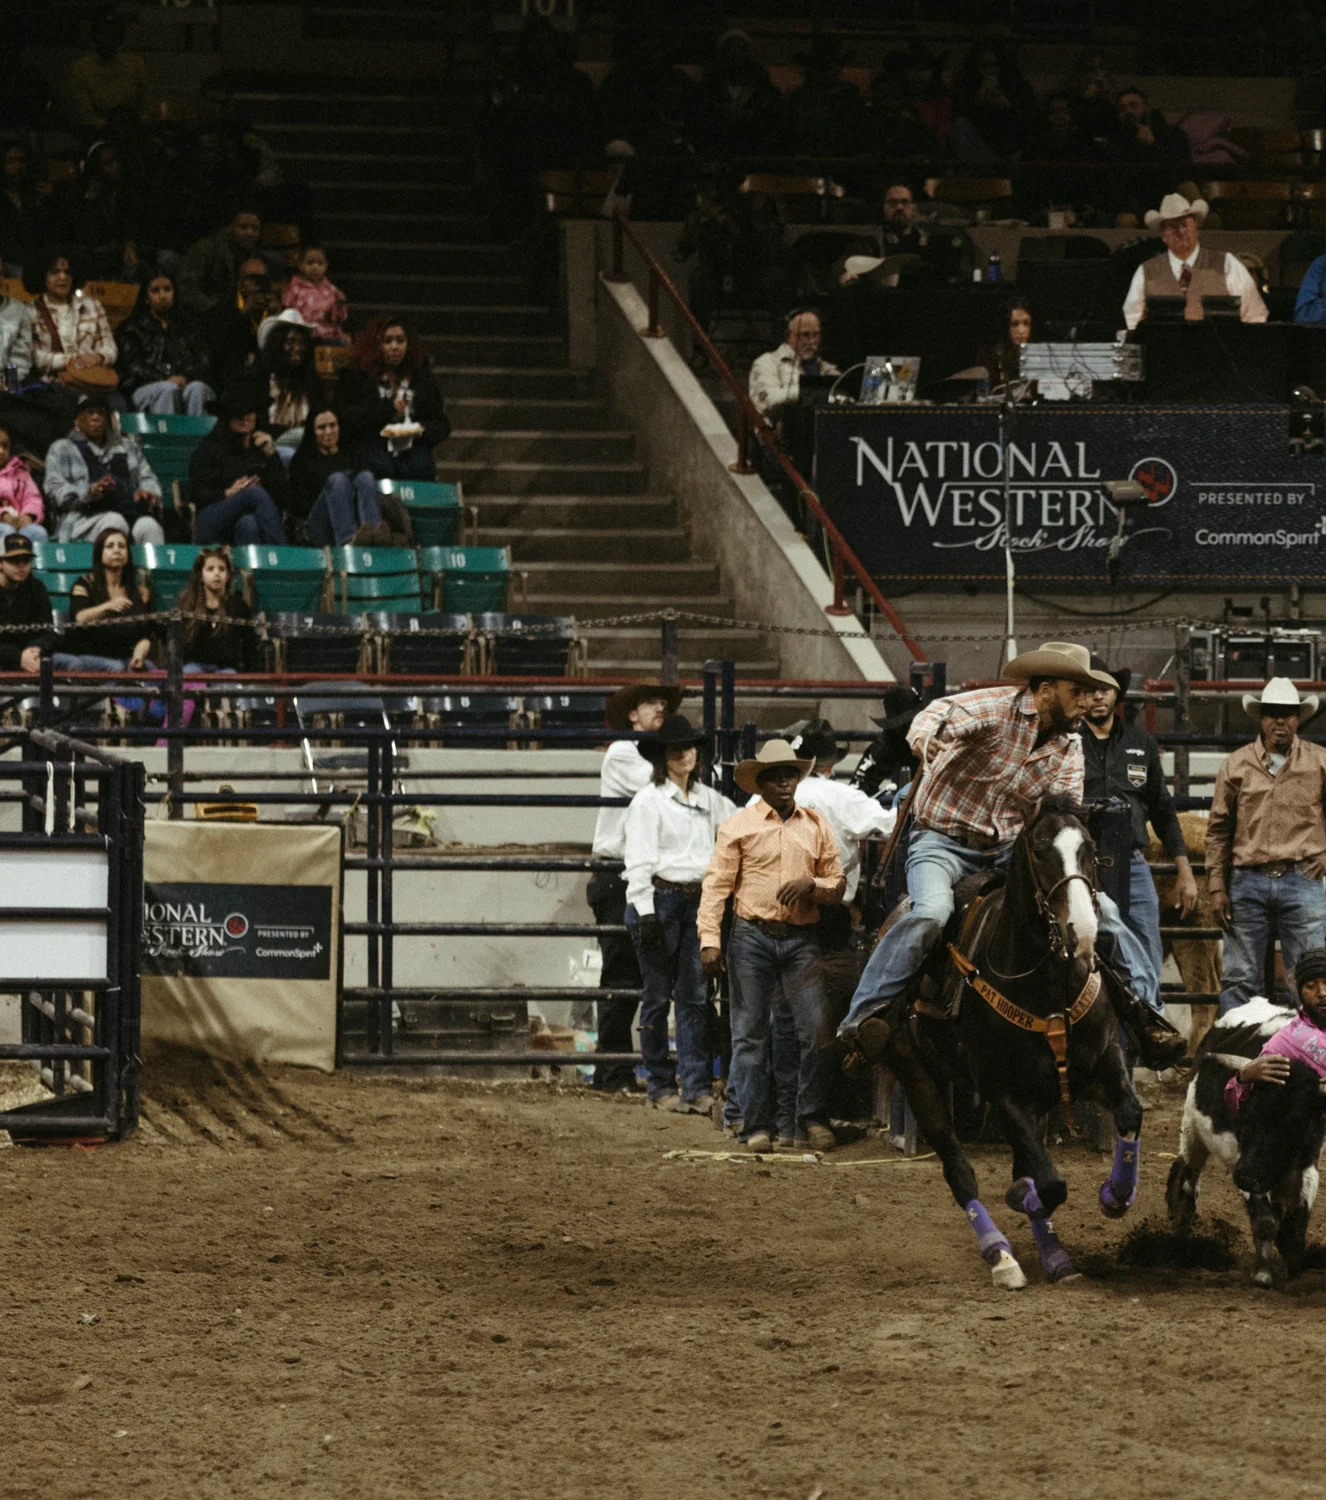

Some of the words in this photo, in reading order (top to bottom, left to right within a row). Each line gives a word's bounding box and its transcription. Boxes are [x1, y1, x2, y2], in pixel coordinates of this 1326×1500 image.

[850, 436, 1100, 486] NATIONAL
[1198, 492, 1283, 505] PRESENTED
[1287, 492, 1306, 505] BY
[1195, 528, 1321, 550] CommonSpirit
[55, 547, 67, 564] 6
[166, 549, 176, 565] 7
[267, 551, 279, 566] 8
[362, 552, 374, 568] 9
[451, 552, 467, 568] 10
[144, 902, 212, 924] IONAL
[147, 926, 222, 947] STERN
[257, 930, 299, 939] PRESENTED
[980, 984, 995, 1004] PAT
[996, 999, 1035, 1030] HOOPER
